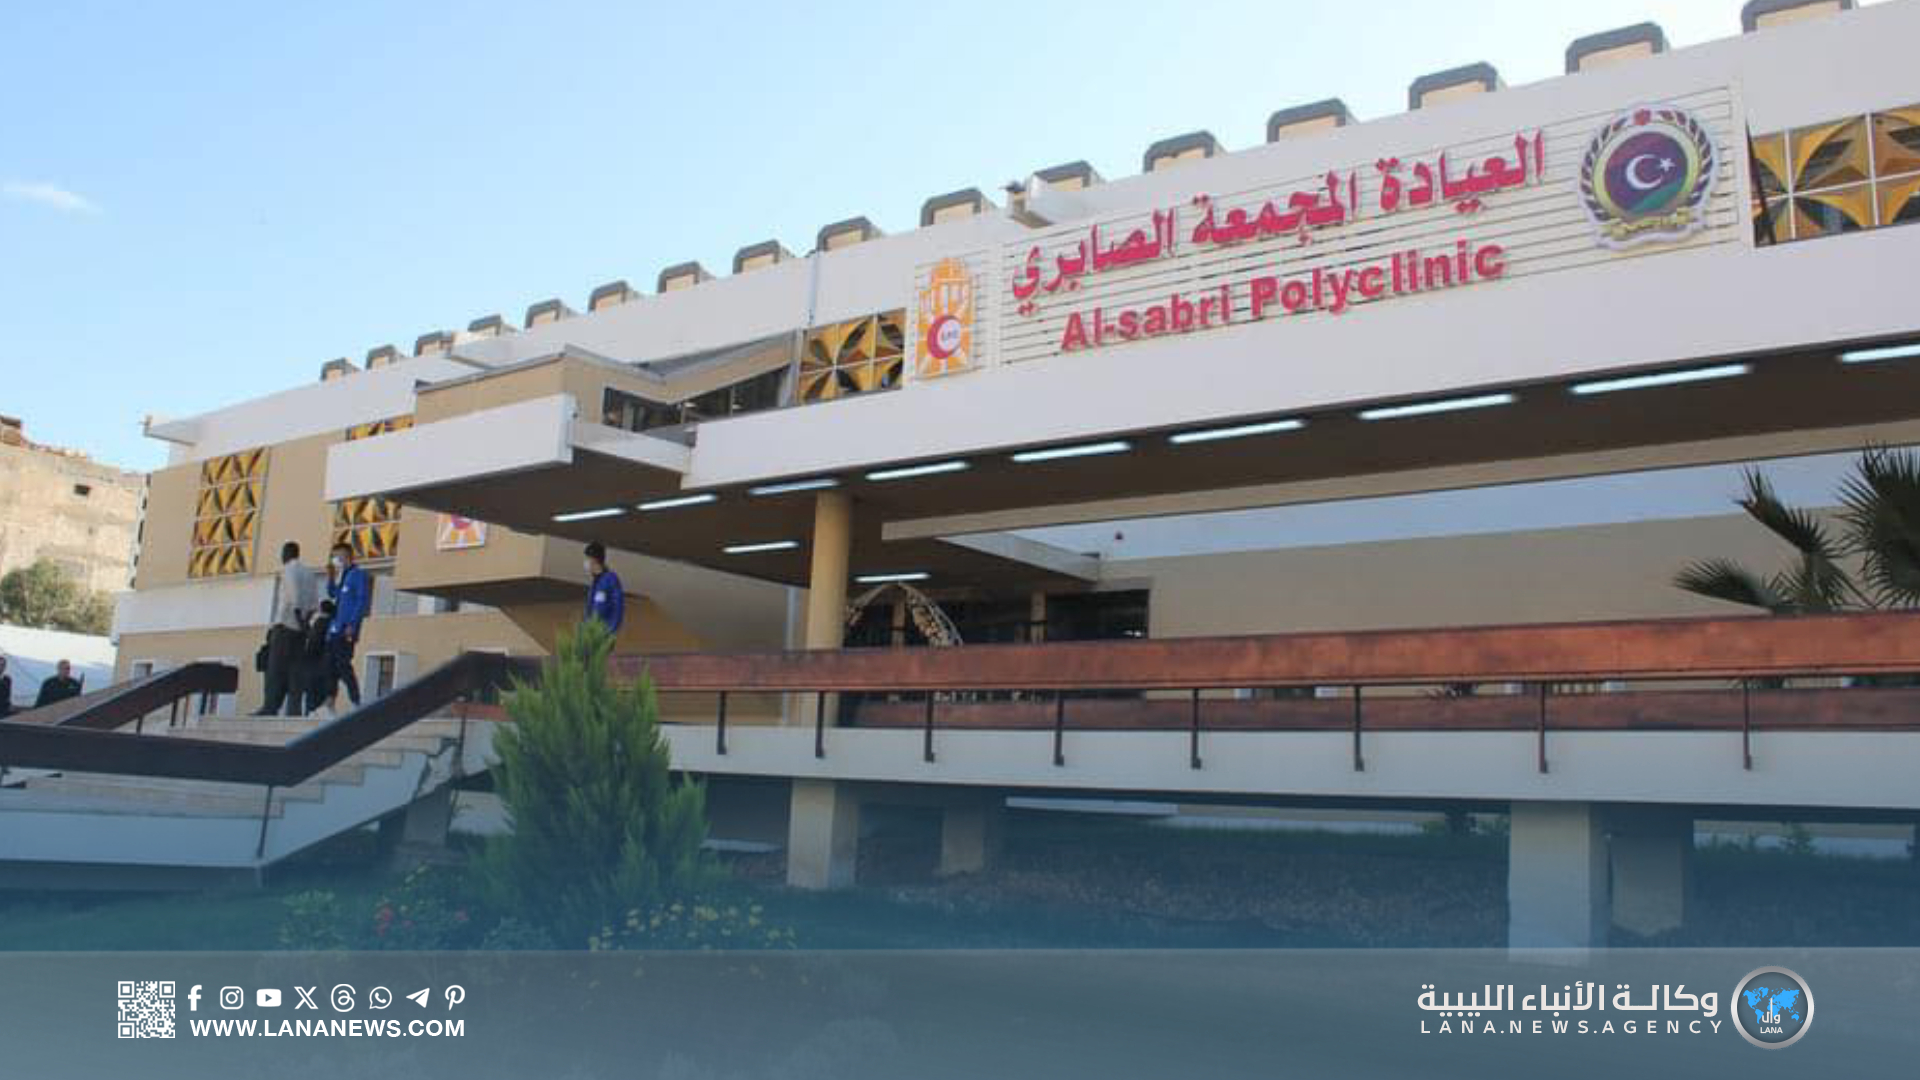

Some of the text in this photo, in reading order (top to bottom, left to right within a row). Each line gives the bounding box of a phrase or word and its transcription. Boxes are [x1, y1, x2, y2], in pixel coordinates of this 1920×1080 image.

[1012, 128, 1546, 317] العيادة المجمعة الصابري
[1061, 239, 1506, 351] Al-sabri Polyclinic
